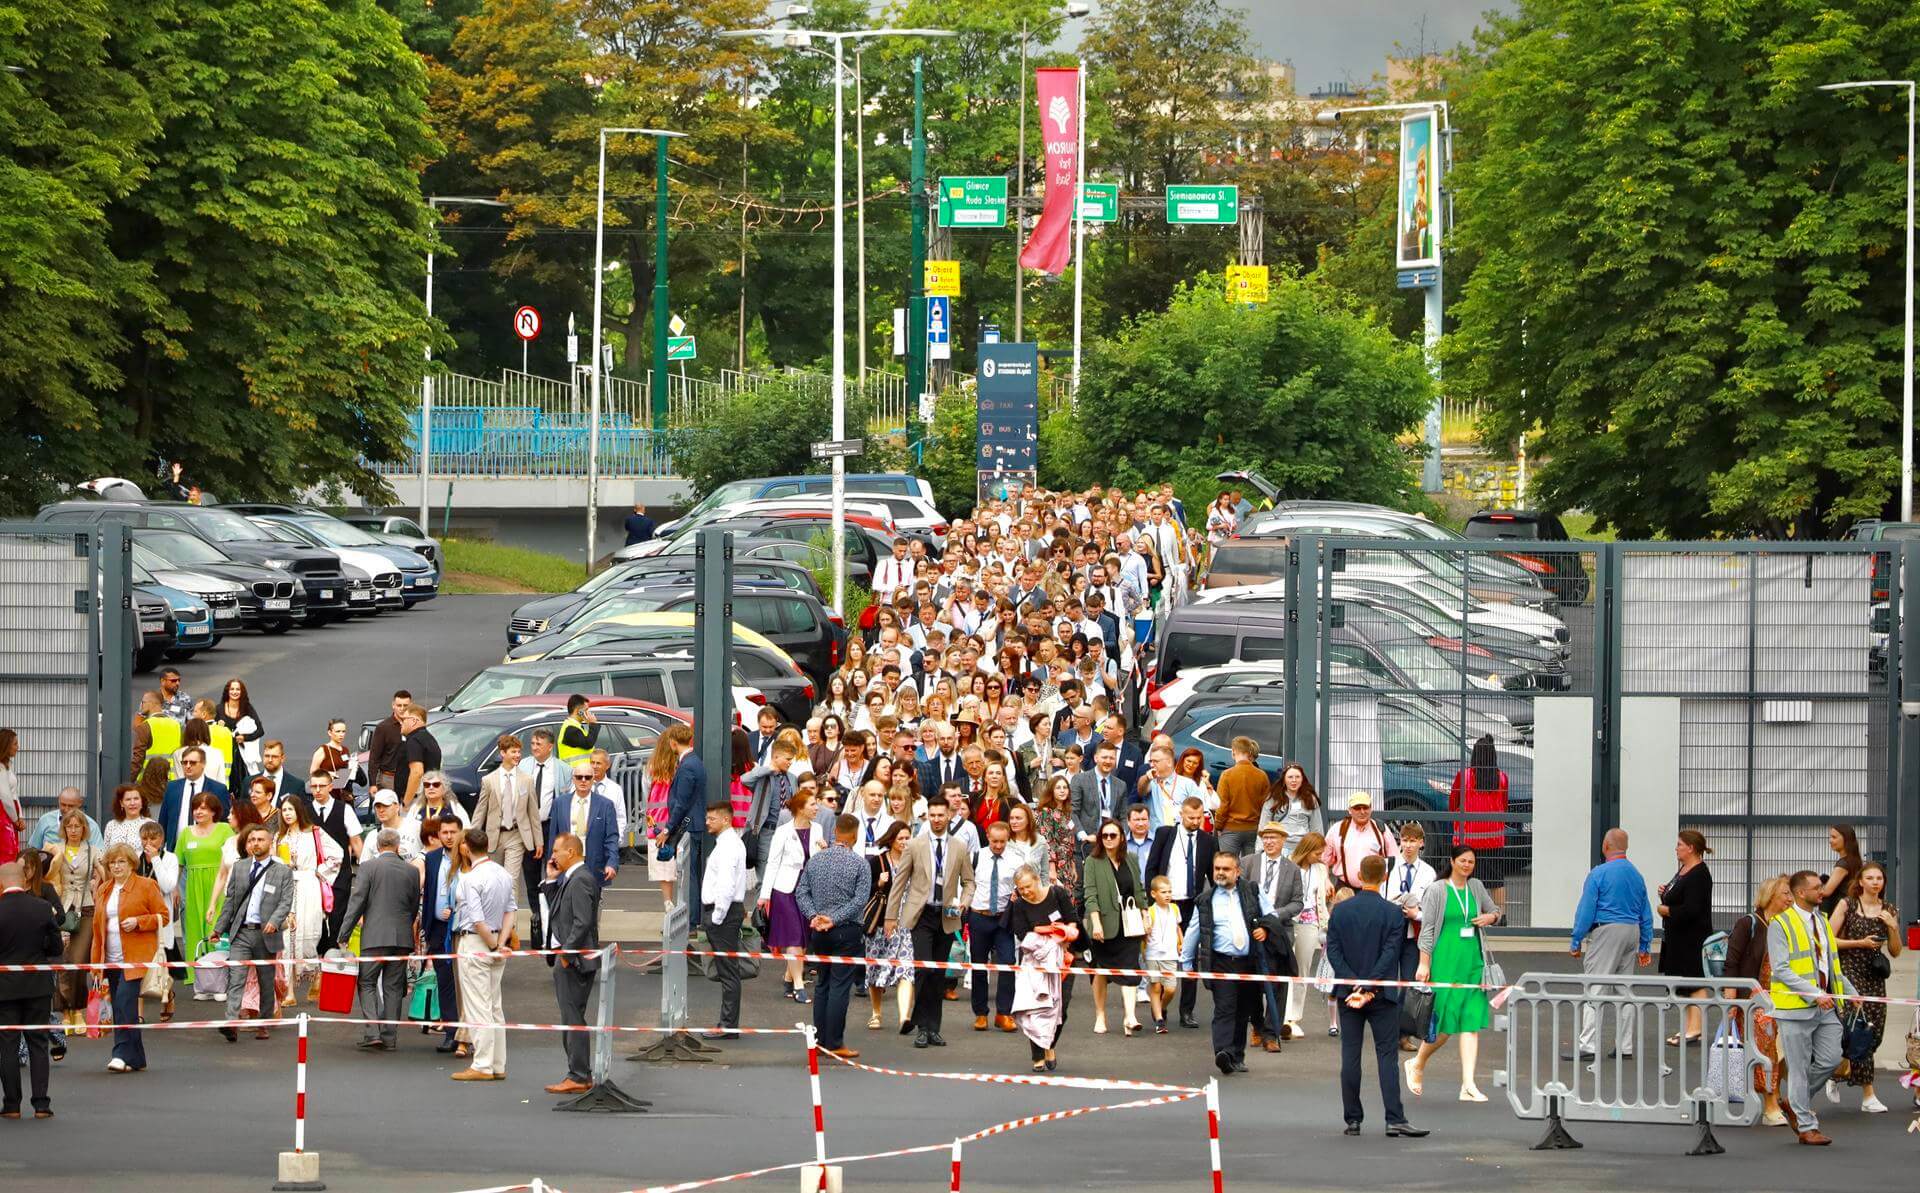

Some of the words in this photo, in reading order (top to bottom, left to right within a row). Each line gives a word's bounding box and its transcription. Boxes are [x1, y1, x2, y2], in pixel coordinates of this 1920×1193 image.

[966, 181, 989, 190] Gliwice
[966, 195, 982, 205] Ruda
[1170, 190, 1216, 200] Siemianowice
